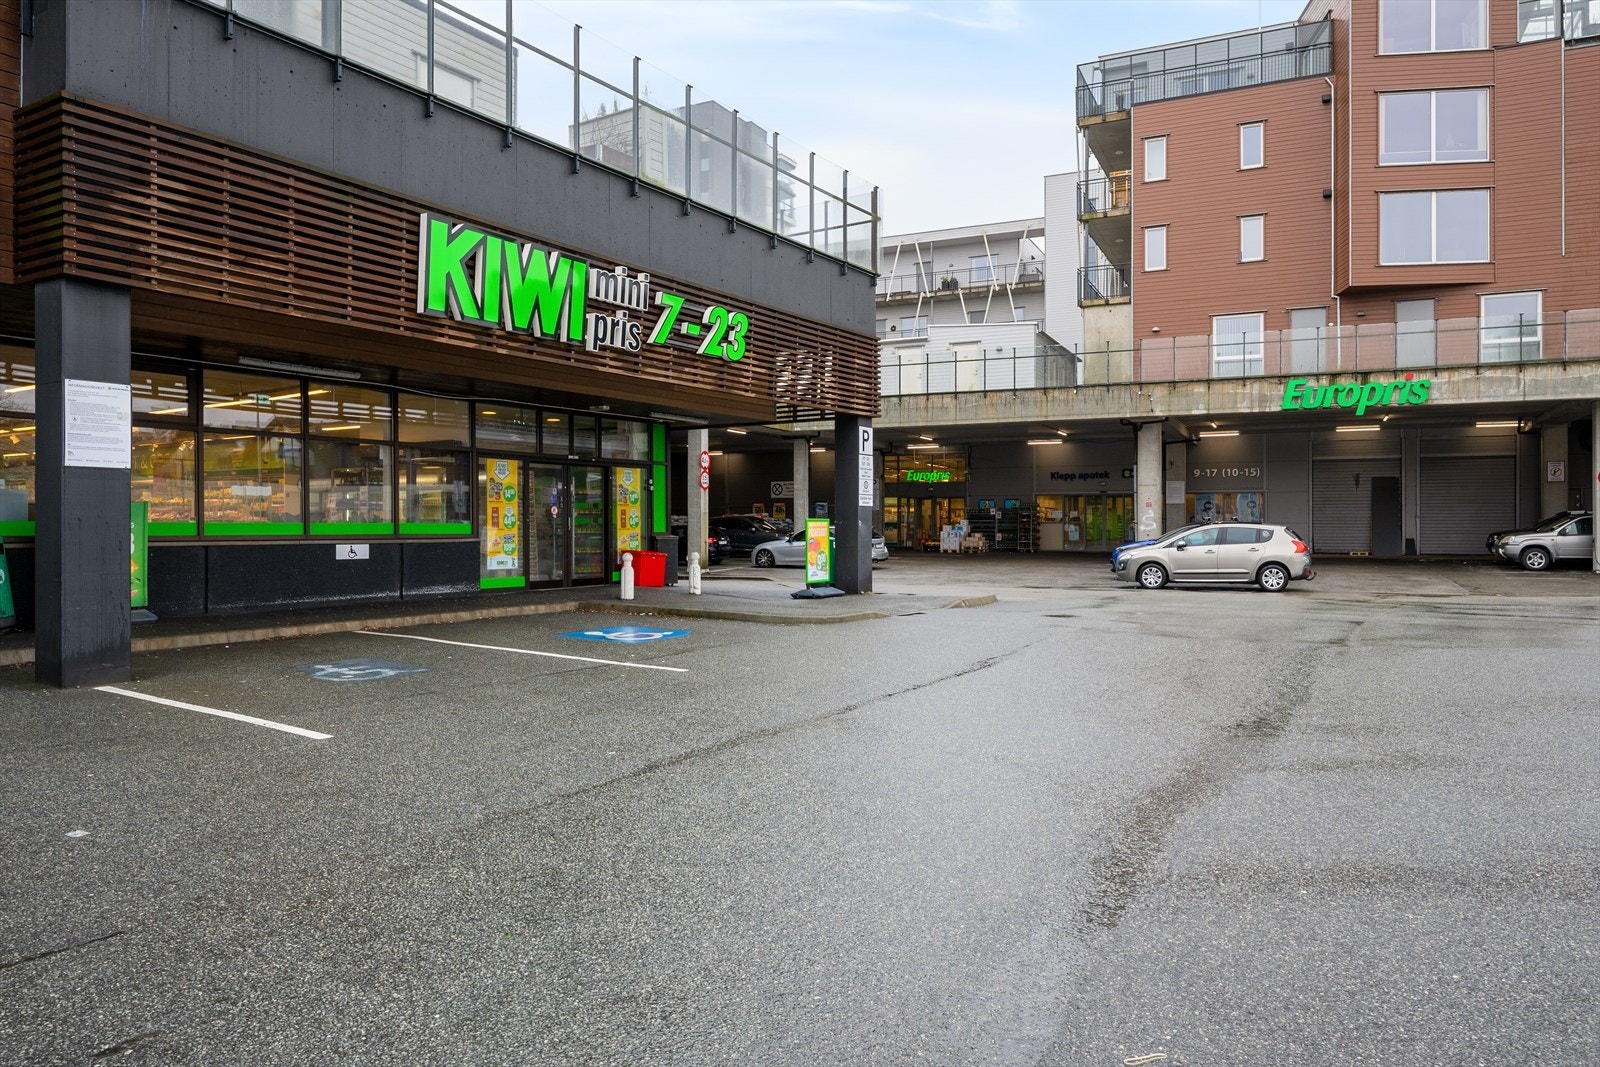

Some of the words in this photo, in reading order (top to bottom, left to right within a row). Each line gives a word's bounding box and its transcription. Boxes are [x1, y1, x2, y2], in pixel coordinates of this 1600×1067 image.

[416, 212, 589, 344] KIWI
[589, 266, 650, 311] mini
[585, 310, 642, 352] pris
[1281, 372, 1431, 416] Europris
[862, 429, 870, 452] P
[906, 469, 951, 484] Europris
[1050, 471, 1076, 481] Klepp
[1078, 470, 1110, 481] apotek
[1193, 468, 1218, 477] 9-17
[1222, 467, 1260, 478] (10-15)
